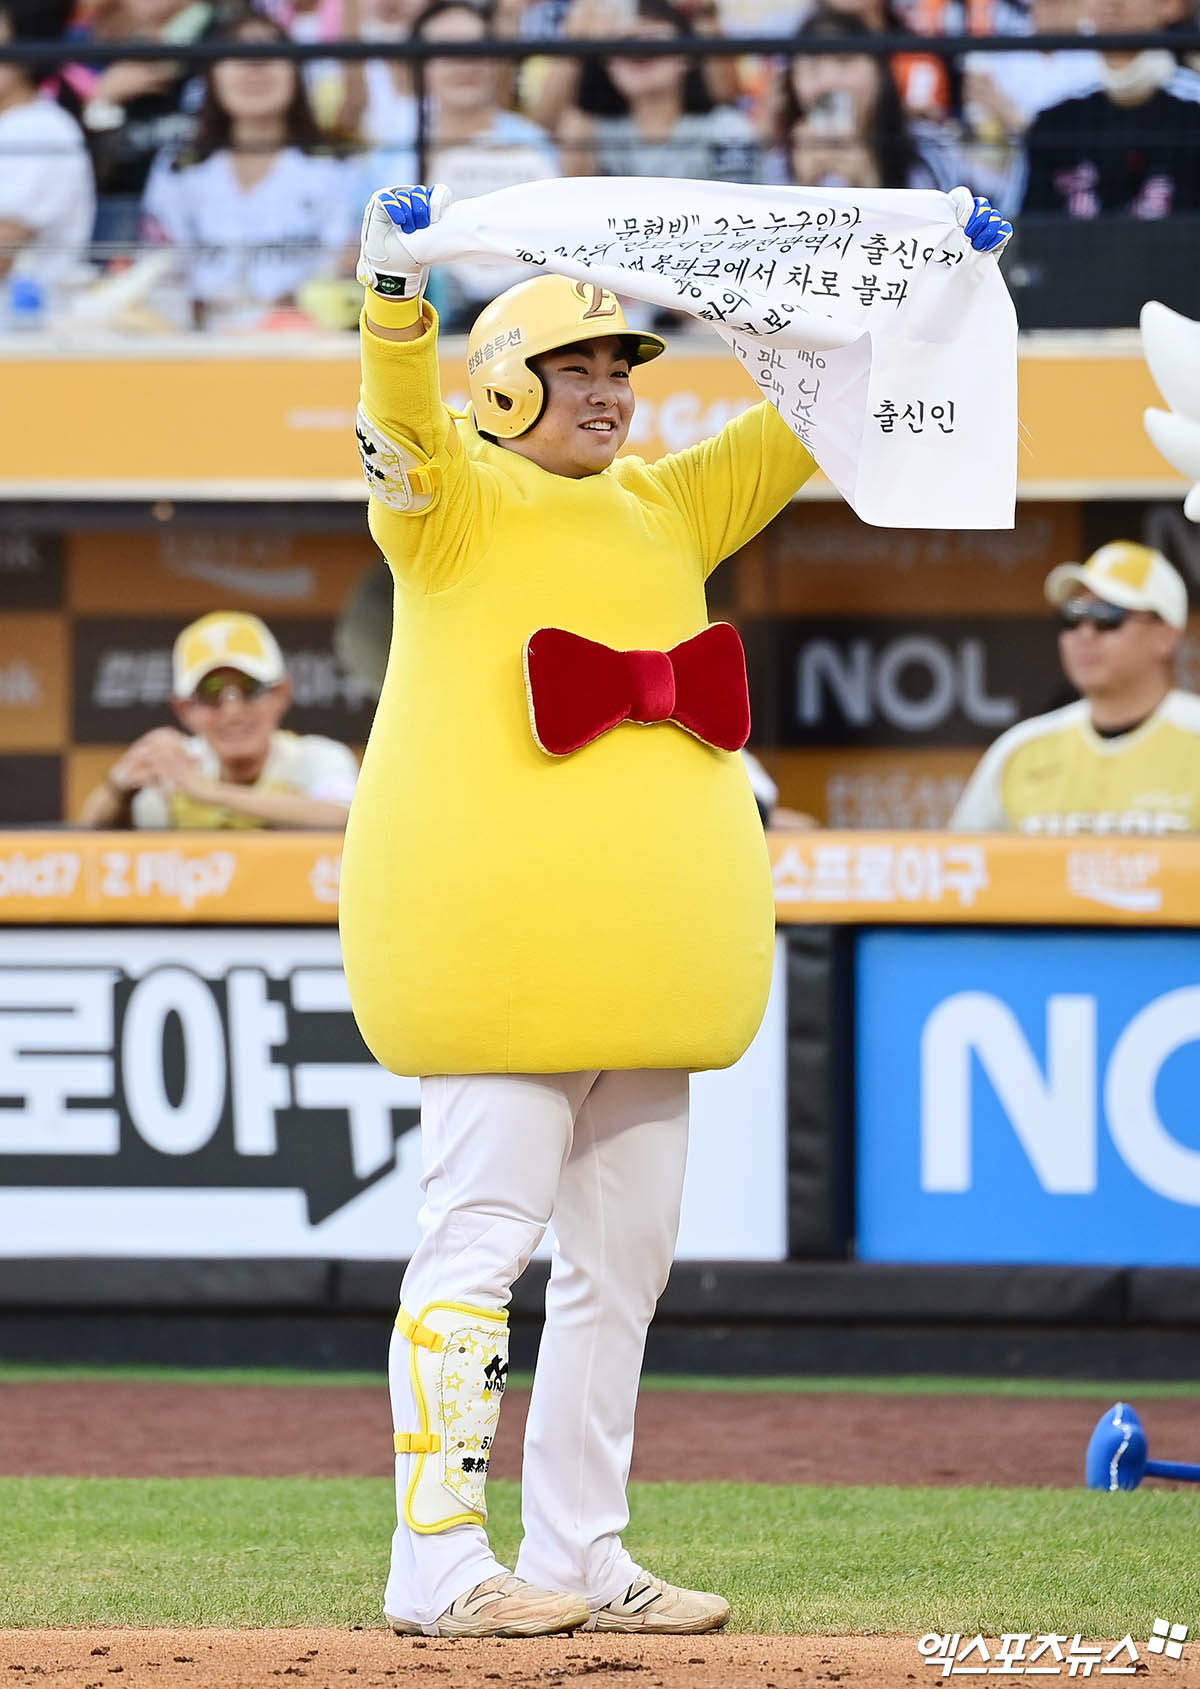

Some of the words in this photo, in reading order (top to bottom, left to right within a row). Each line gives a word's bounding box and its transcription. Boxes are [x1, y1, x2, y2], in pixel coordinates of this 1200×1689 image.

[607, 214, 701, 241] "문현빈"
[703, 214, 756, 238] 그는
[763, 206, 862, 233] 누구인가
[728, 233, 854, 260] 대전광역시
[784, 264, 841, 297] 차로
[852, 274, 909, 310] 불과
[468, 327, 522, 375] 한화솔루션
[873, 400, 955, 433] 출신인
[801, 637, 1017, 729] NOL
